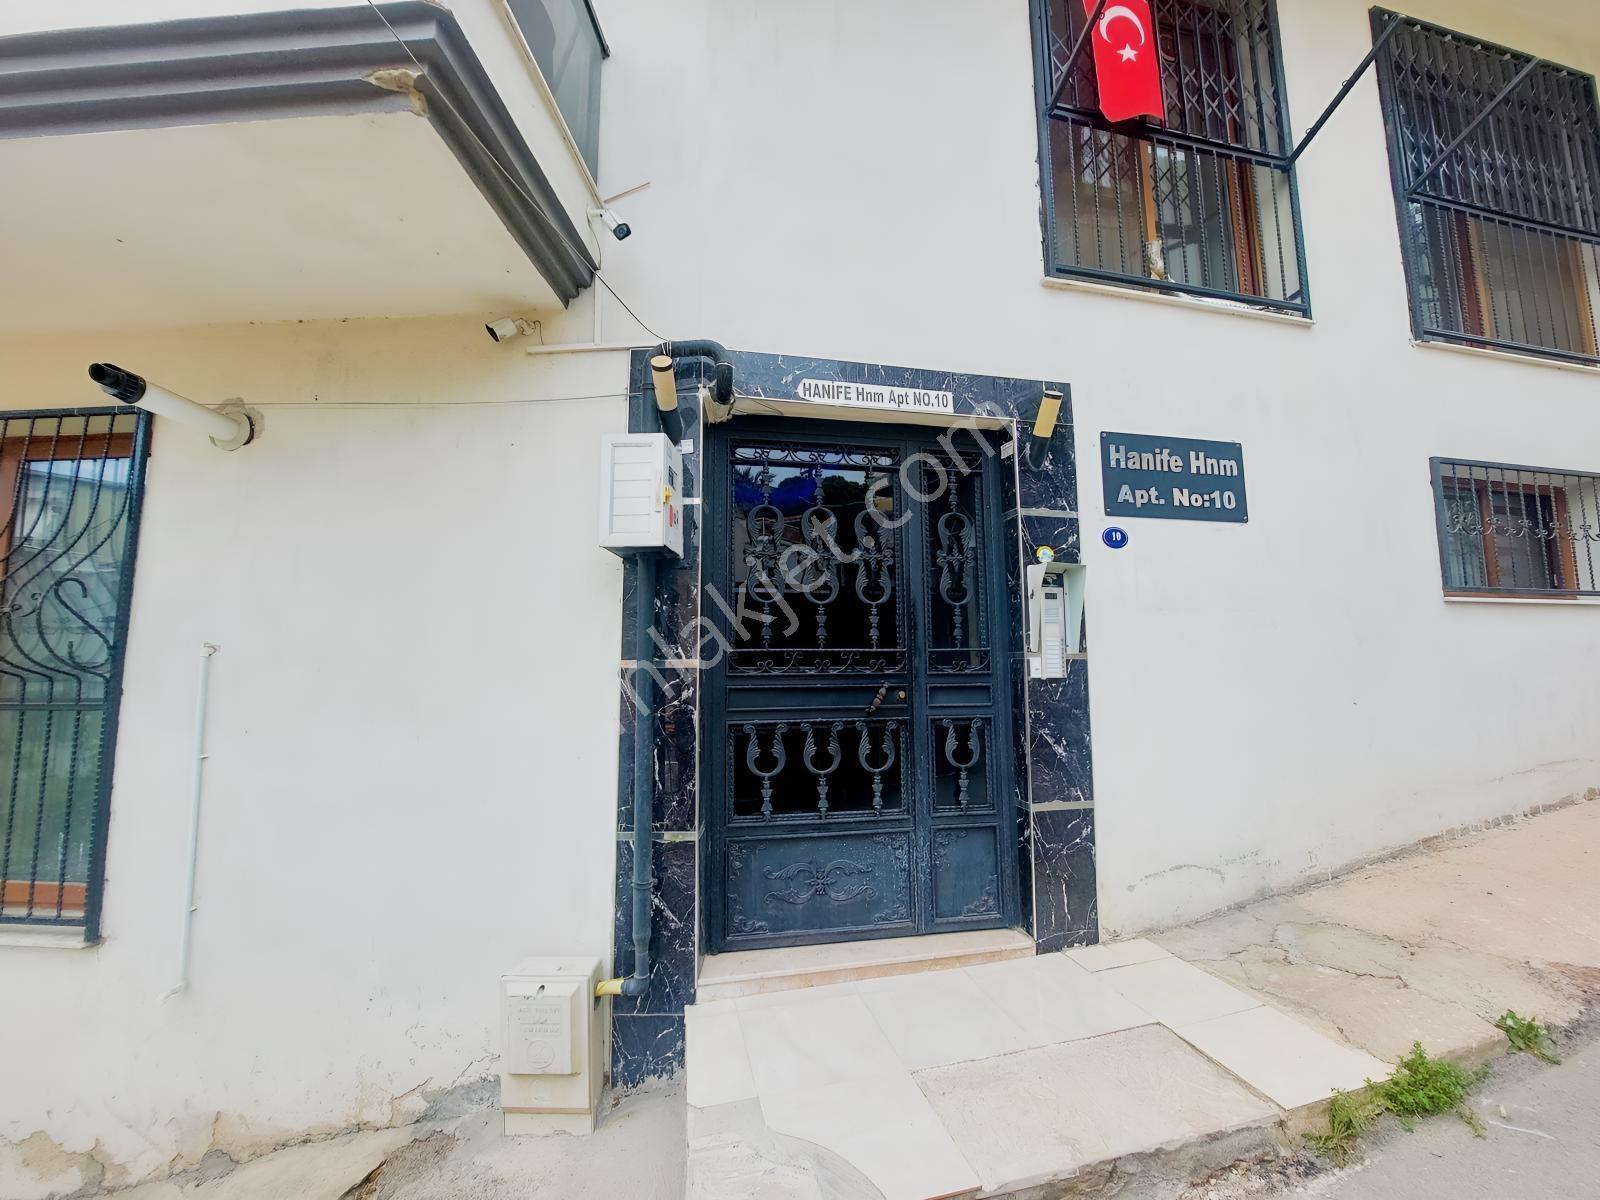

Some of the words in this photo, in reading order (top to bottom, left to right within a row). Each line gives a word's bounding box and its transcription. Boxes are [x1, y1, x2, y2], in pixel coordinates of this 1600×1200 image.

[856, 386, 884, 404] Hnm
[888, 389, 909, 408] Apt
[913, 391, 949, 408] NO.10
[1109, 444, 1183, 473] Hanife
[1189, 450, 1238, 477] Hnm
[1117, 484, 1166, 508] Apt.
[1172, 487, 1236, 510] No:10
[1111, 531, 1122, 541] 10
